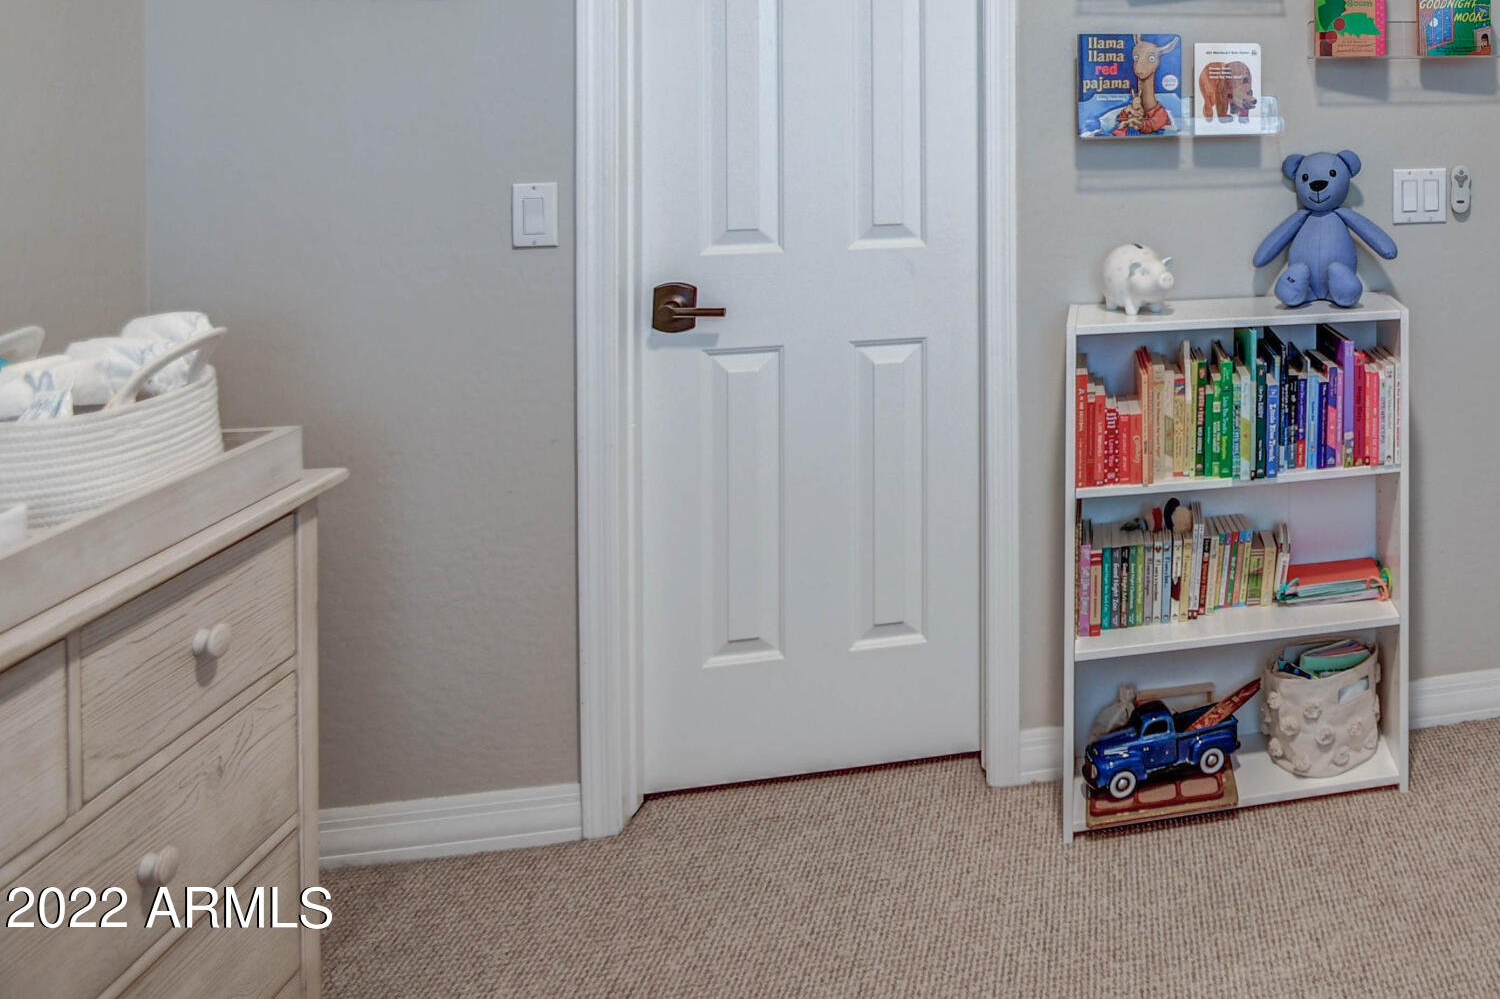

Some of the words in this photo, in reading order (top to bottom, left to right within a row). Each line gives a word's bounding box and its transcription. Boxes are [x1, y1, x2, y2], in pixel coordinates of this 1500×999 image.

[1346, 0, 1374, 7] Boom
[1453, 9, 1487, 23] MOON
[1087, 36, 1125, 49] llama
[1087, 49, 1125, 63] llama
[1094, 62, 1119, 76] red
[1082, 77, 1131, 93] pajama
